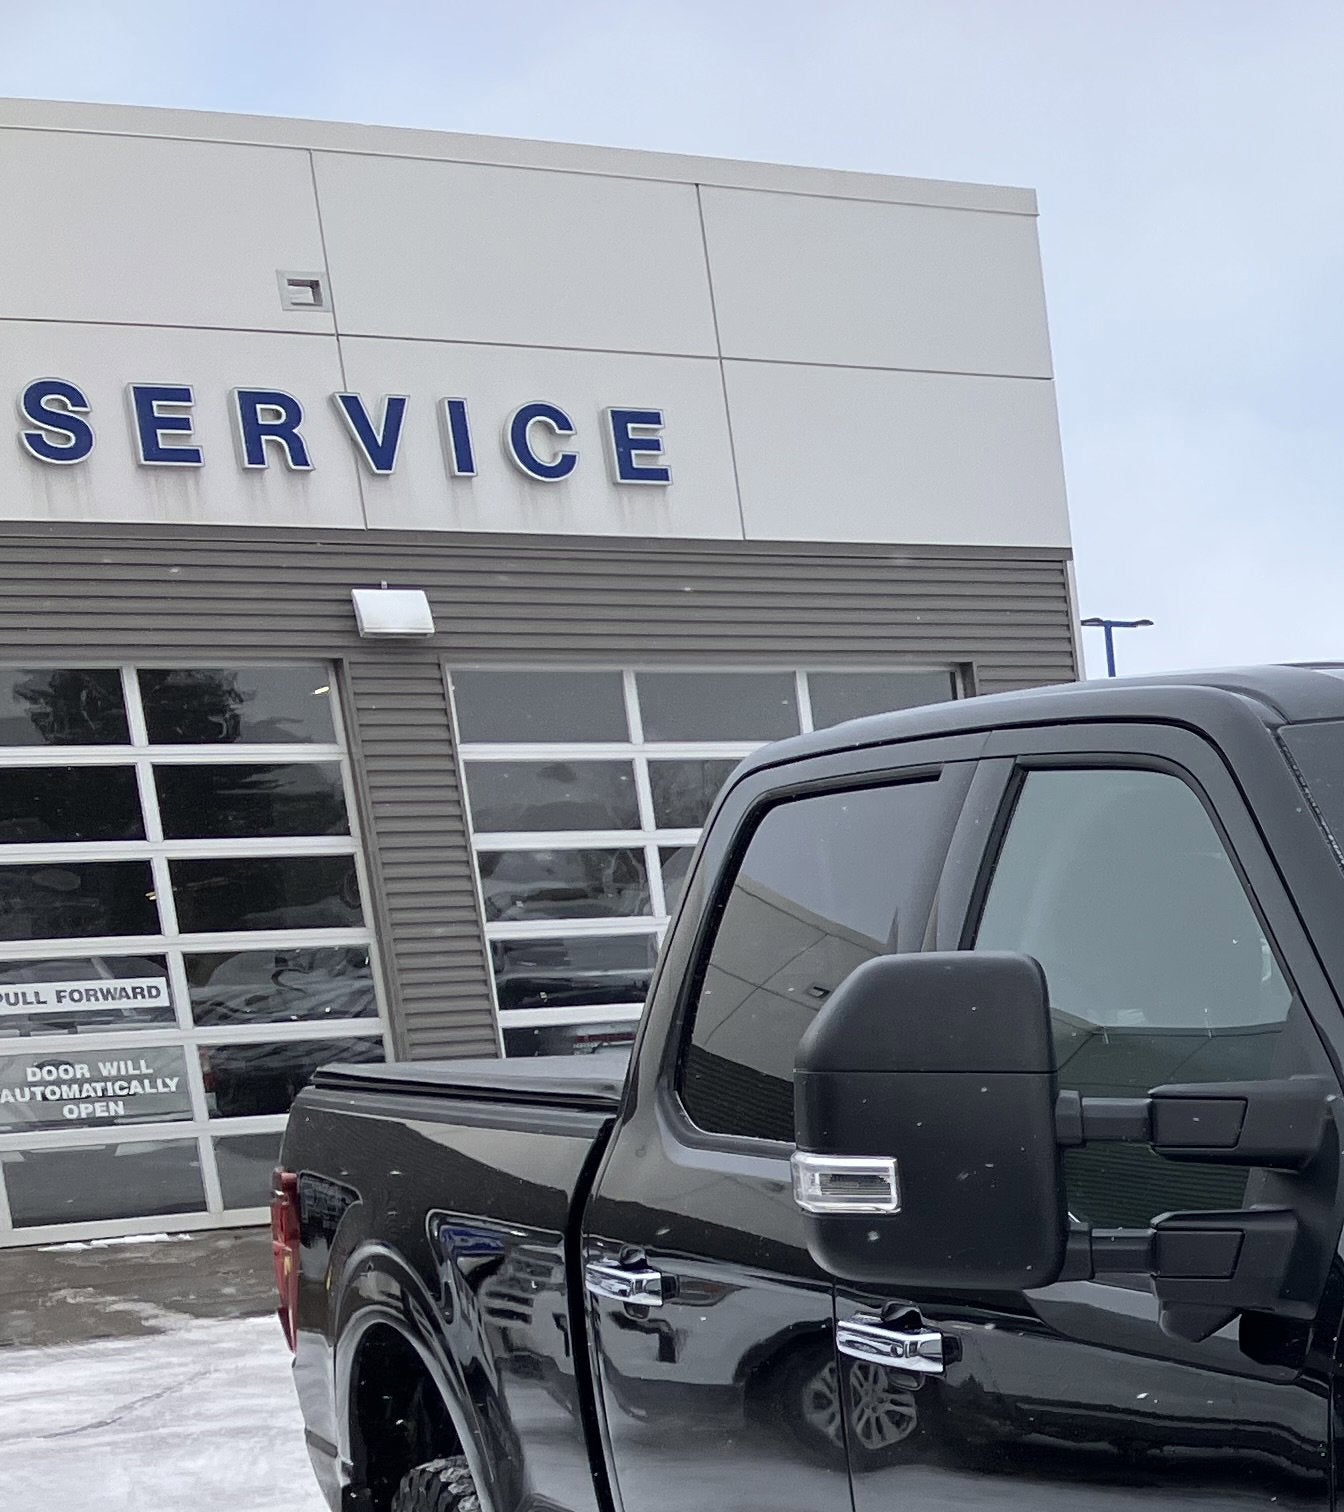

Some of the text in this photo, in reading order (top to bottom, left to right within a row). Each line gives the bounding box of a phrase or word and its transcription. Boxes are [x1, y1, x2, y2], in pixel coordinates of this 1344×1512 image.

[16, 376, 673, 486] SERVICE
[55, 985, 161, 1004] FORWARD
[26, 1059, 154, 1082] DOOR WILL
[0, 1076, 180, 1103] AUTOMATICALLY
[62, 1100, 125, 1119] OPEN
